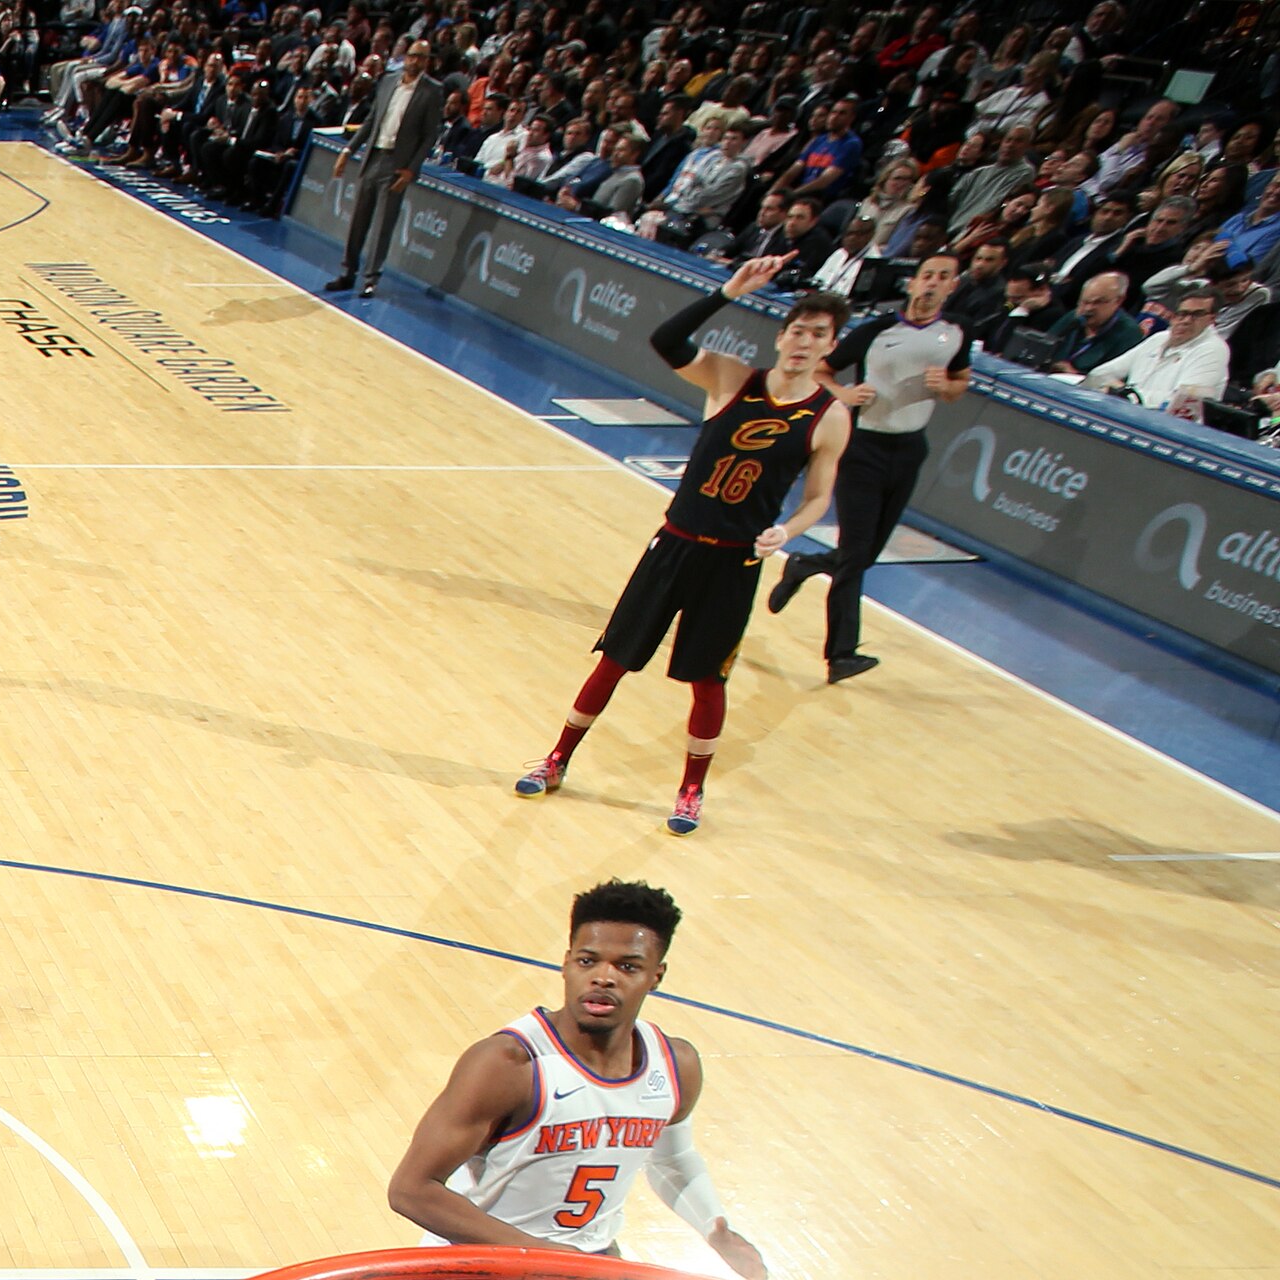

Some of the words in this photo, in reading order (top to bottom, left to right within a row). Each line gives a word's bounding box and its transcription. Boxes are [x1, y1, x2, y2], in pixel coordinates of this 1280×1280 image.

[93, 165, 231, 223] DRAFTKINGS
[493, 240, 535, 275] altice
[589, 278, 637, 317] altice
[23, 262, 140, 306] MADISON
[90, 309, 209, 354] SQUARE
[155, 358, 292, 412] GARDEN
[701, 326, 759, 365] altice
[731, 418, 790, 451] C
[699, 454, 763, 505] 16
[1002, 447, 1089, 500] altice
[992, 490, 1062, 533] business
[1216, 529, 1280, 584] alti
[534, 1117, 606, 1154] NEW
[553, 1165, 620, 1229] 5
